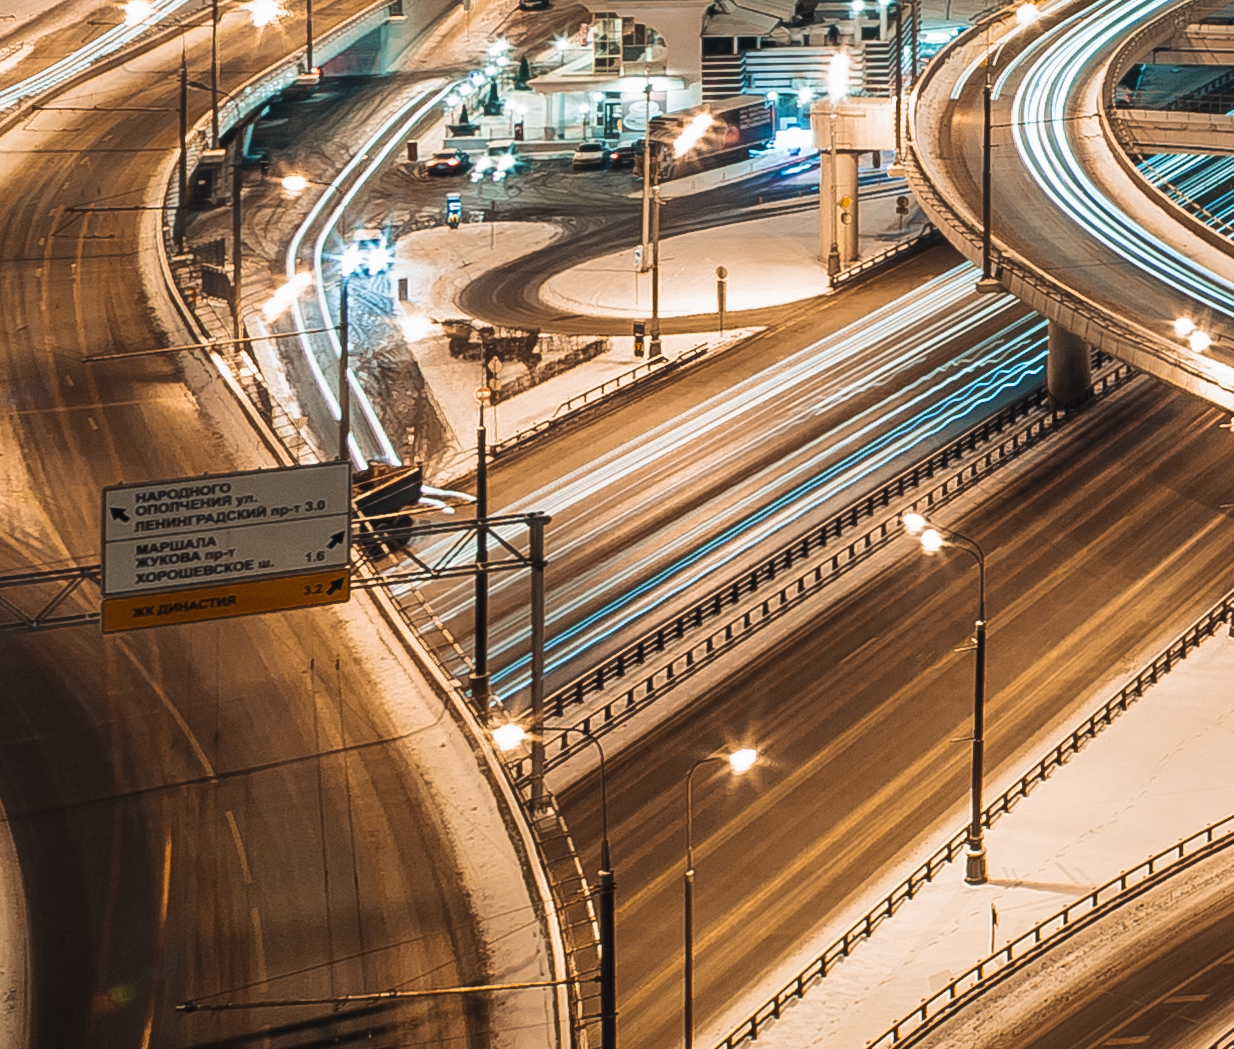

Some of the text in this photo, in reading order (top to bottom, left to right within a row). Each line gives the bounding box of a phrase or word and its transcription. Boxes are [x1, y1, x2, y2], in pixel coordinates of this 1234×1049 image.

[135, 483, 231, 503] НАРОДНОГО
[134, 499, 326, 532] ЛЕНИНГРАДСКИЙ пр-т 3.0
[135, 494, 258, 517] ОПОЛЧЕНИЯ ул.
[136, 536, 217, 556] МАРШАЛА
[135, 548, 236, 569] ЖУКОВА пр-т
[135, 551, 325, 584] ХОРОШЕВСКОЕ ш. 1.6
[132, 583, 323, 618] ЖК ДИНАСТИЯ 3.2
